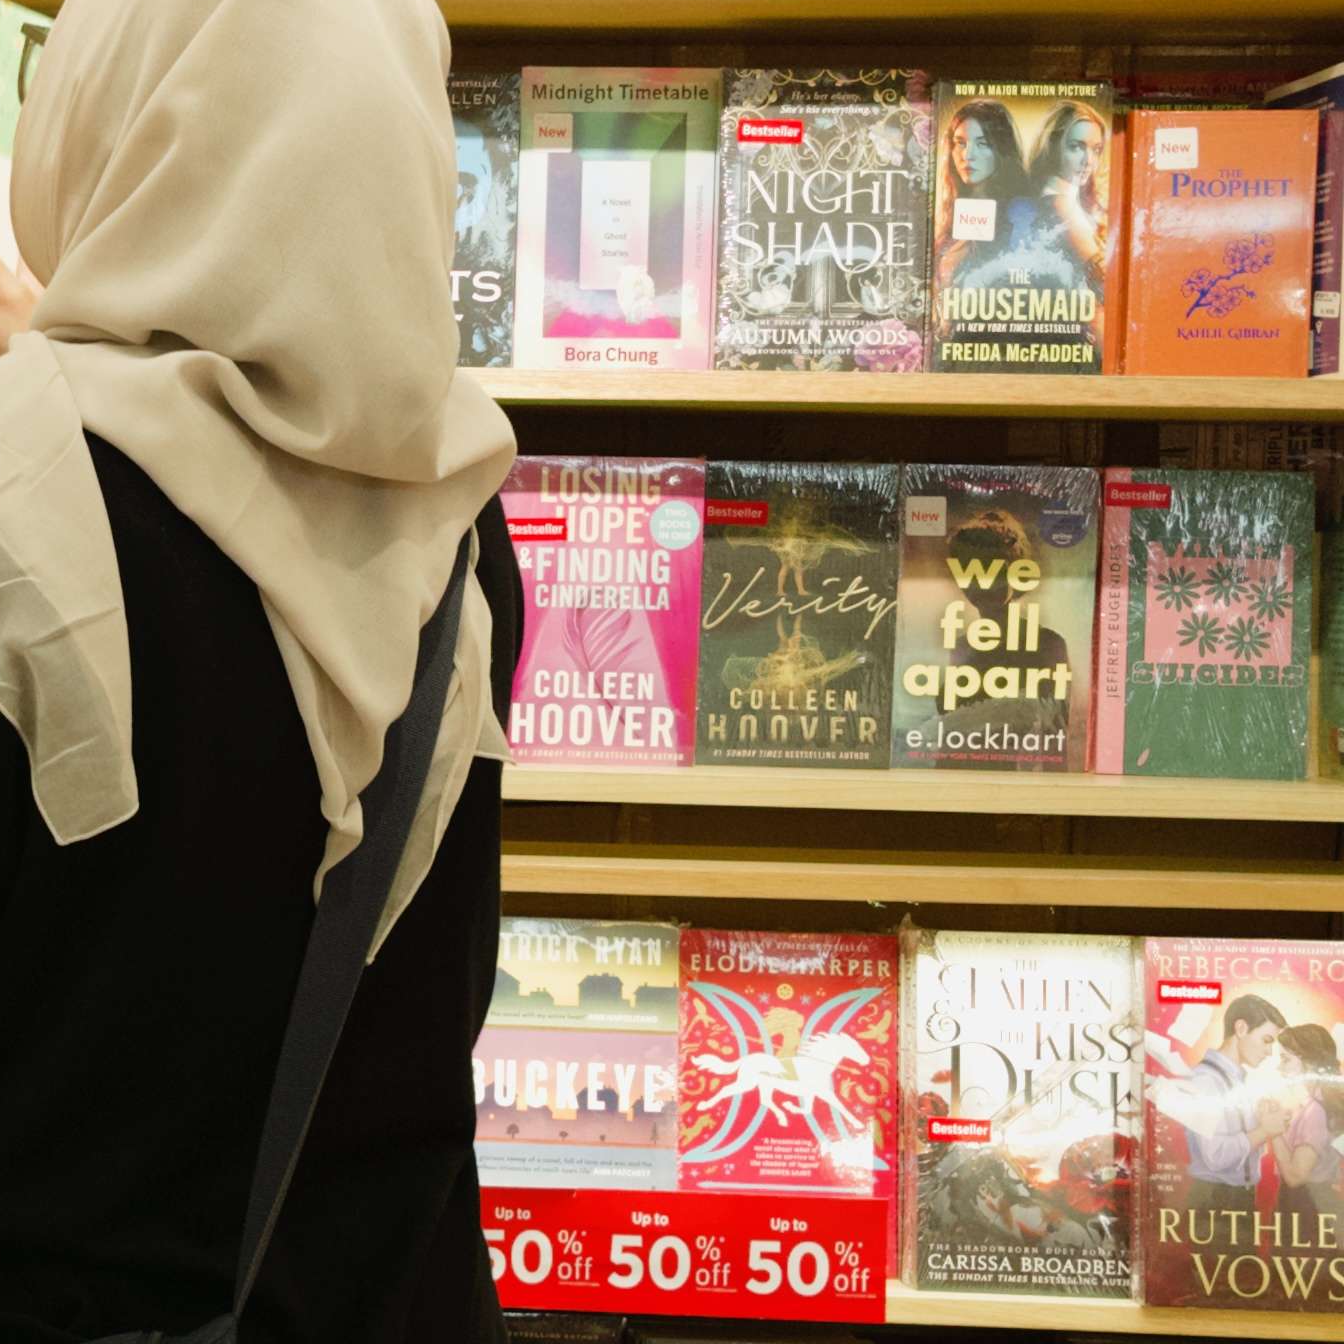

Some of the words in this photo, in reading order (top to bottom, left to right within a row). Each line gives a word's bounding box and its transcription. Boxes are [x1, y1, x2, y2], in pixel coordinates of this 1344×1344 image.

[531, 83, 614, 102] Midnight
[619, 83, 710, 101] Timetable
[538, 125, 567, 138] New
[745, 170, 909, 215] NIGHT
[731, 220, 914, 274] SHADE
[1009, 268, 1032, 285] THE
[942, 287, 1096, 322] HOUSEMAID
[563, 346, 603, 363] Bora
[605, 346, 659, 366] Chung
[941, 343, 1000, 362] FREIDA
[1005, 343, 1094, 363] McFADDEN
[518, 547, 533, 570] &
[535, 548, 672, 586] FINDING
[945, 557, 1043, 591] we
[535, 583, 671, 612] CINDERELLA
[940, 600, 1042, 652] fell
[533, 670, 655, 701] COLLEEN
[902, 662, 1073, 712] apart
[510, 702, 676, 749] HOOVER
[905, 721, 1068, 753] e.lockhart
[745, 1239, 830, 1297] 50
[833, 1266, 871, 1293] off
[927, 1253, 1013, 1272] CARISSA
